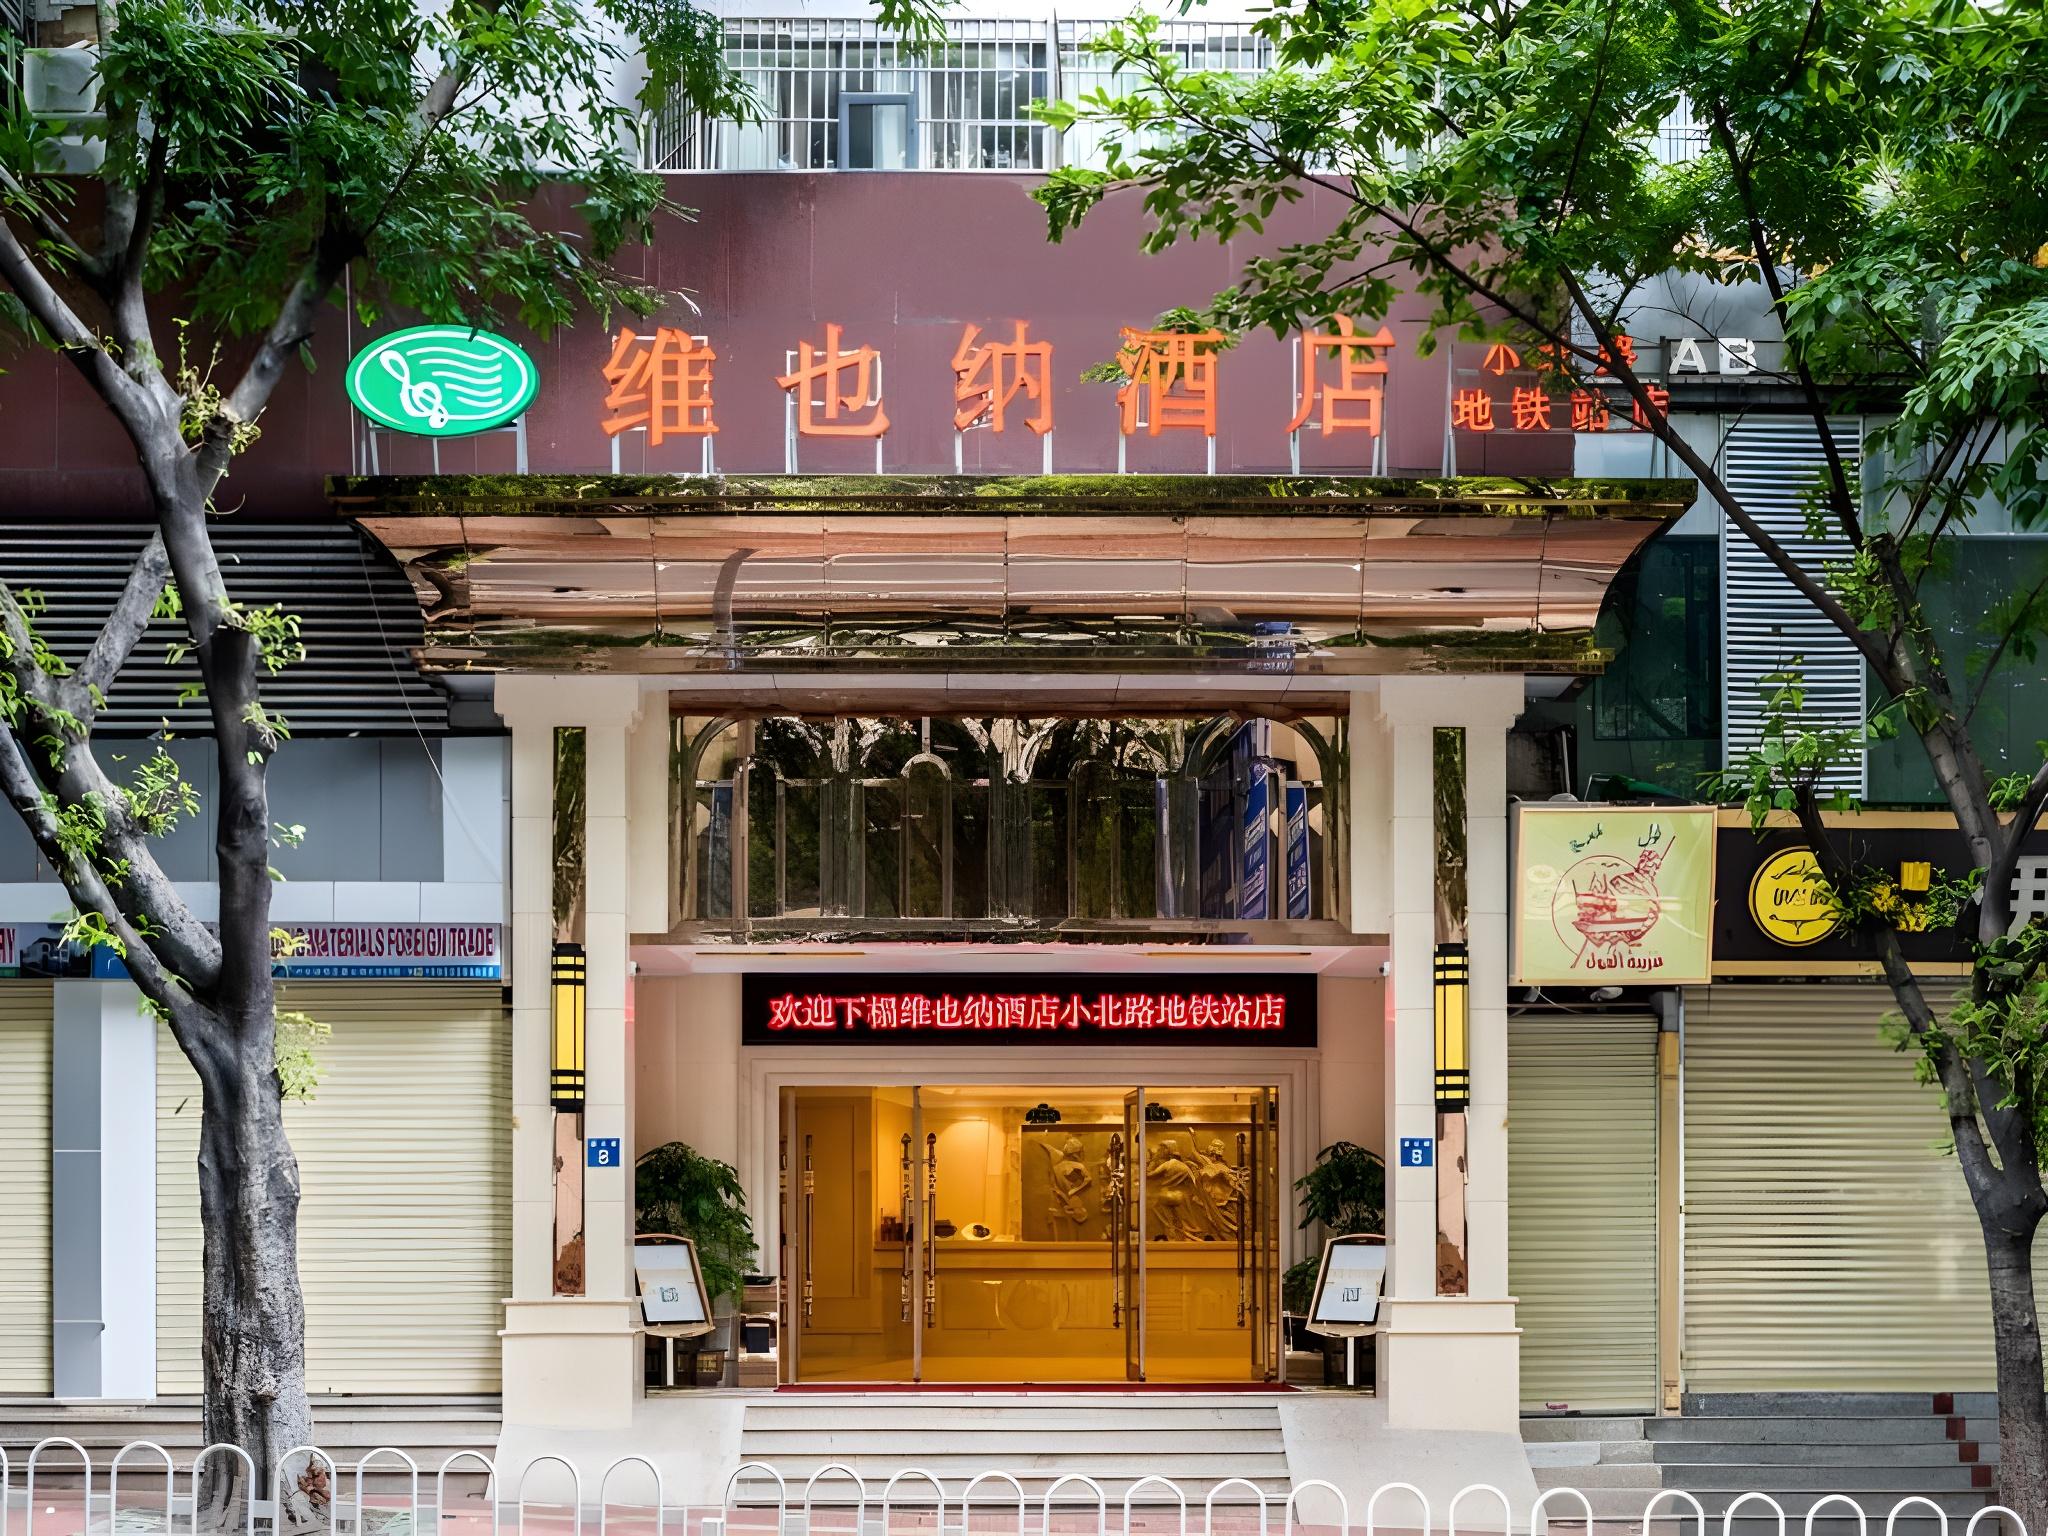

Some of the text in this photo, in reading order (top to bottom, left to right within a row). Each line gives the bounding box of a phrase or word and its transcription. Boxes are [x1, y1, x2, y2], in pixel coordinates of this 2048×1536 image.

[601, 313, 1396, 446] 维也纳酒店
[449, 927, 495, 957] TRADE
[768, 993, 1287, 1029] 欢迎下榻维也纳酒店小北路地铁站店
